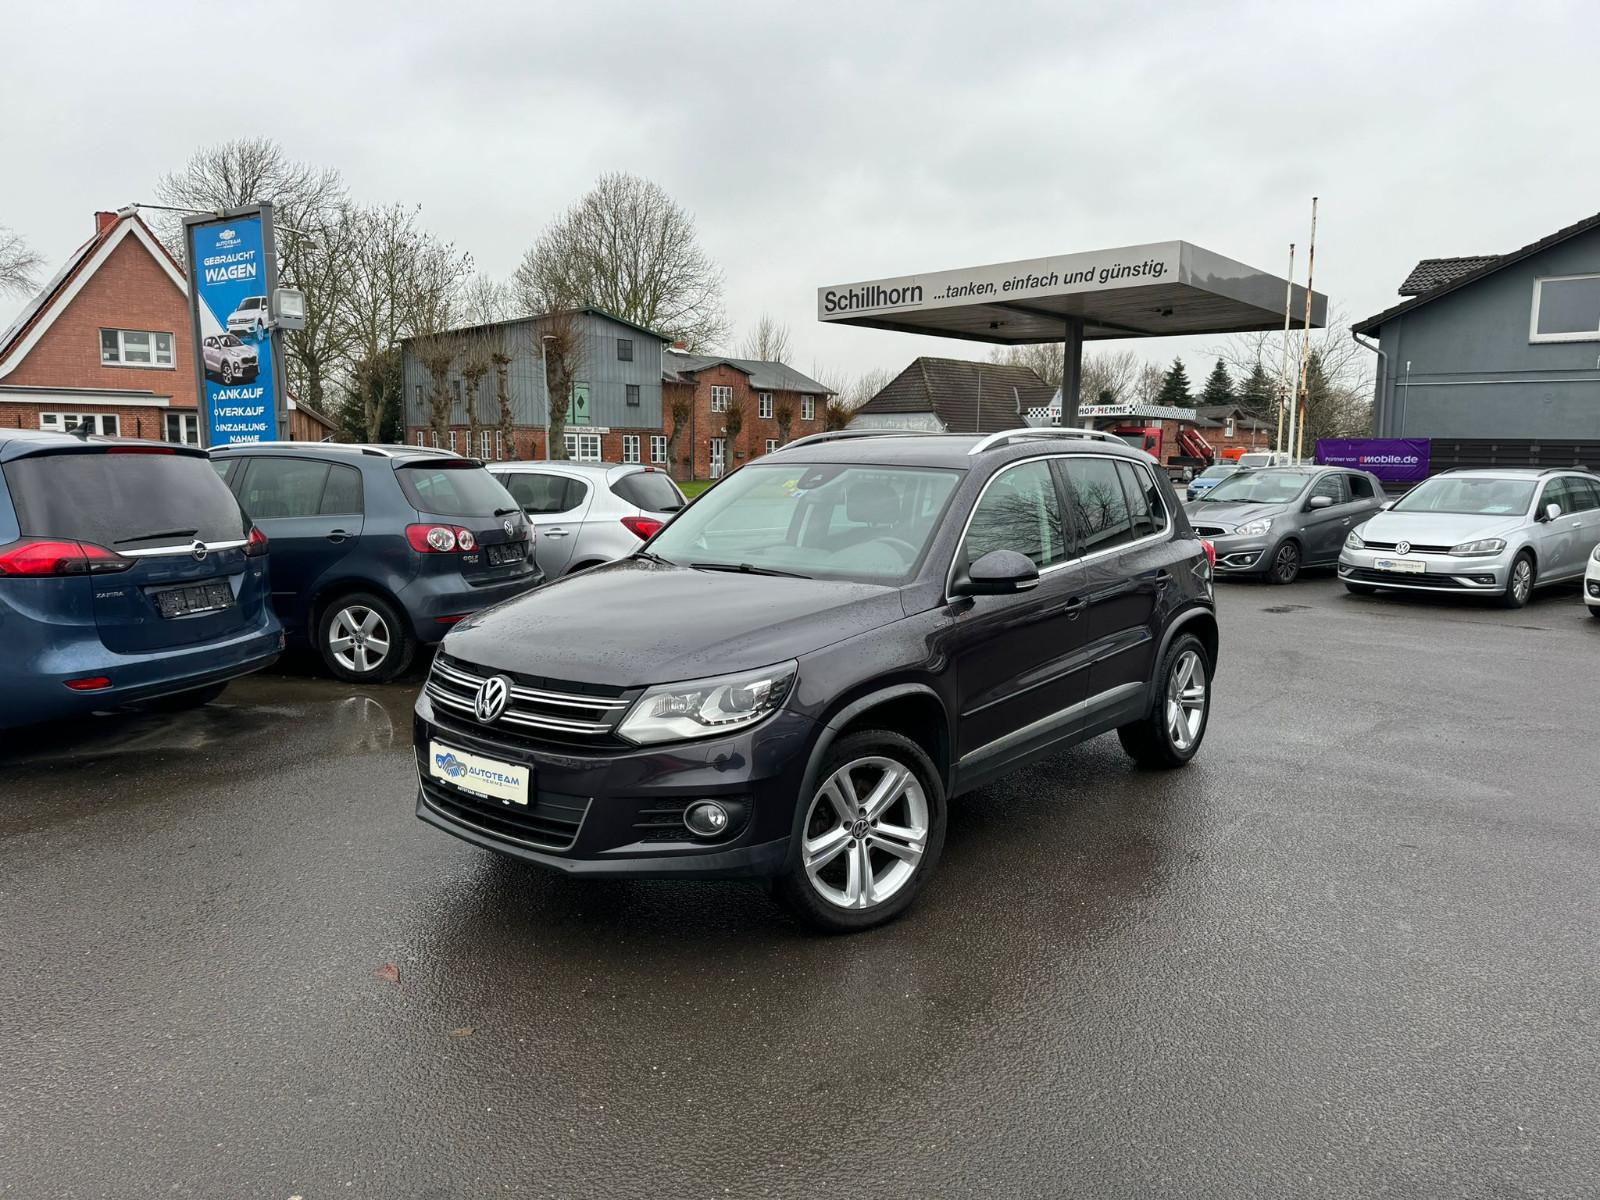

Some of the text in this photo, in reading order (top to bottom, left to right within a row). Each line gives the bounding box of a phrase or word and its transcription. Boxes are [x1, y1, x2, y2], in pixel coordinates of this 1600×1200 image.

[203, 250, 255, 266] GEBRAUCHT
[205, 262, 256, 282] WAGEN
[824, 283, 923, 312] Schillhorn
[1002, 271, 1058, 292] einfach
[1063, 265, 1095, 285] und
[1099, 258, 1169, 284] günstig.
[218, 387, 264, 400] ANKAUF
[218, 406, 264, 417] VERKAUF
[219, 422, 268, 432] INZAHLUNG-
[229, 434, 260, 444] NAHME
[1364, 455, 1418, 464] mobile.de
[468, 766, 520, 786] AUTOTEAM
